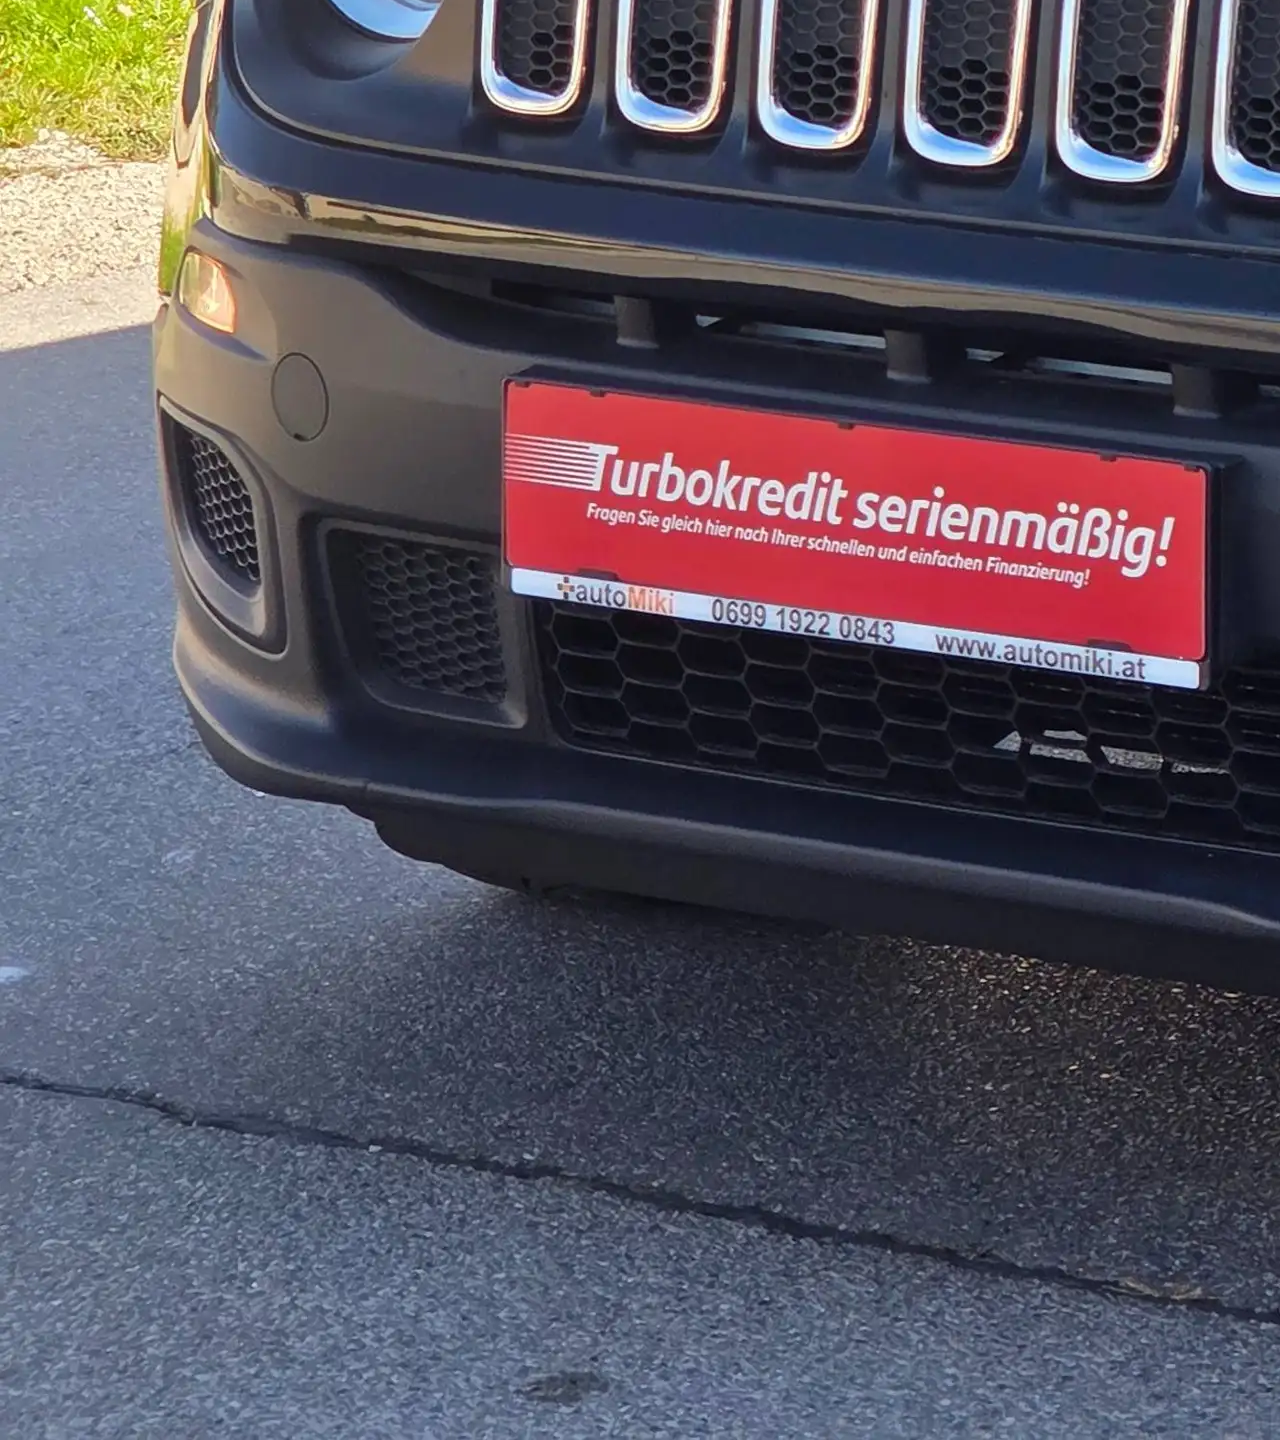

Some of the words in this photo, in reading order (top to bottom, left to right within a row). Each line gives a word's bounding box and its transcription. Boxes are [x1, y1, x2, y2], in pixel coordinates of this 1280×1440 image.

[587, 442, 848, 526] Turbokredit
[852, 485, 1175, 578] serienmäßig!
[587, 502, 635, 526] Fragen
[638, 509, 660, 527] Sie
[661, 513, 703, 534] gleich
[705, 518, 733, 537] hier
[734, 526, 769, 544] nach
[770, 528, 807, 549] Ihrer
[806, 535, 876, 558] schnellen
[877, 545, 908, 563] und
[908, 547, 983, 573] einfachen
[985, 556, 1091, 589] Finanzierung!
[711, 598, 767, 628] 0699
[776, 606, 831, 636] 1922
[838, 615, 896, 645] 0843
[935, 633, 1147, 680] www.automiki.at
